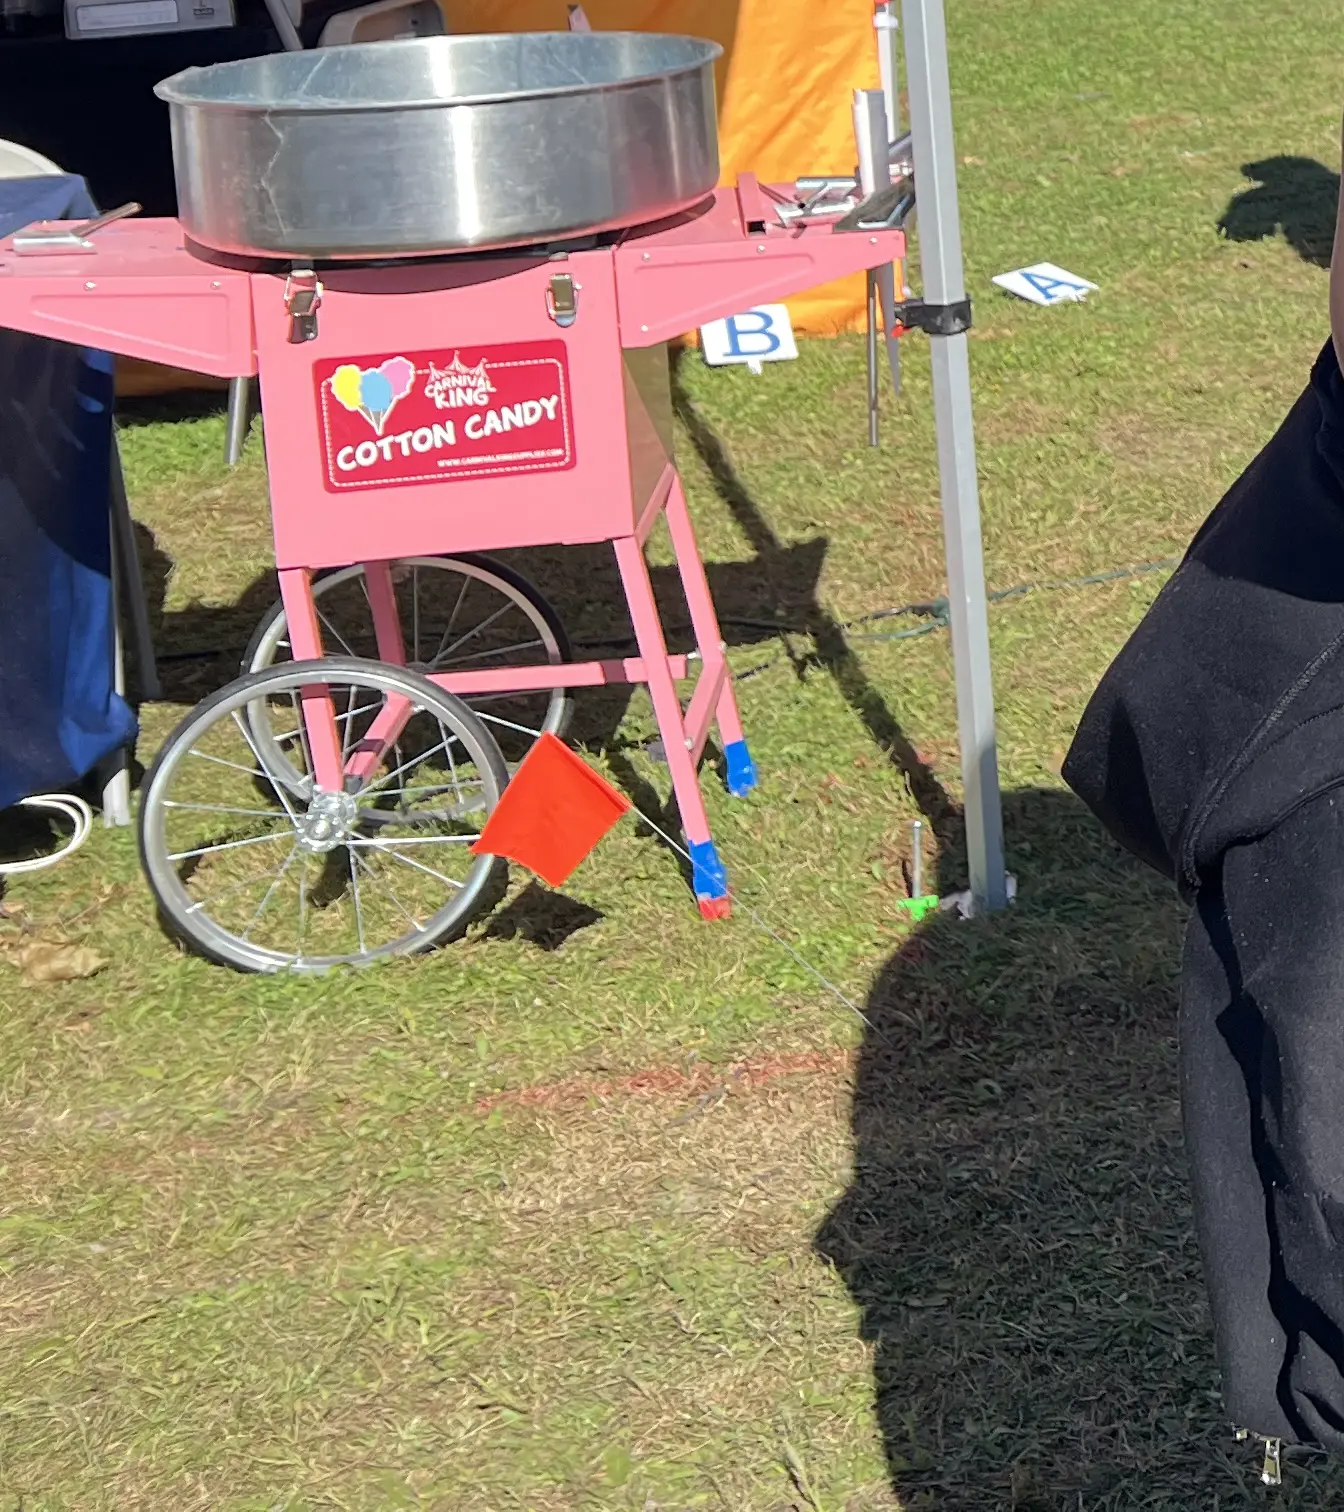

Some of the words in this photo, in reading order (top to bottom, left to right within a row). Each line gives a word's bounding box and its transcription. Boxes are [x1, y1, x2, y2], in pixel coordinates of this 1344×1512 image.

[1018, 270, 1090, 300] A
[722, 309, 781, 357] B
[424, 374, 497, 398] CARNIVAL
[433, 387, 490, 409] KING
[336, 420, 457, 472] COTTON
[464, 394, 559, 440] CANDY
